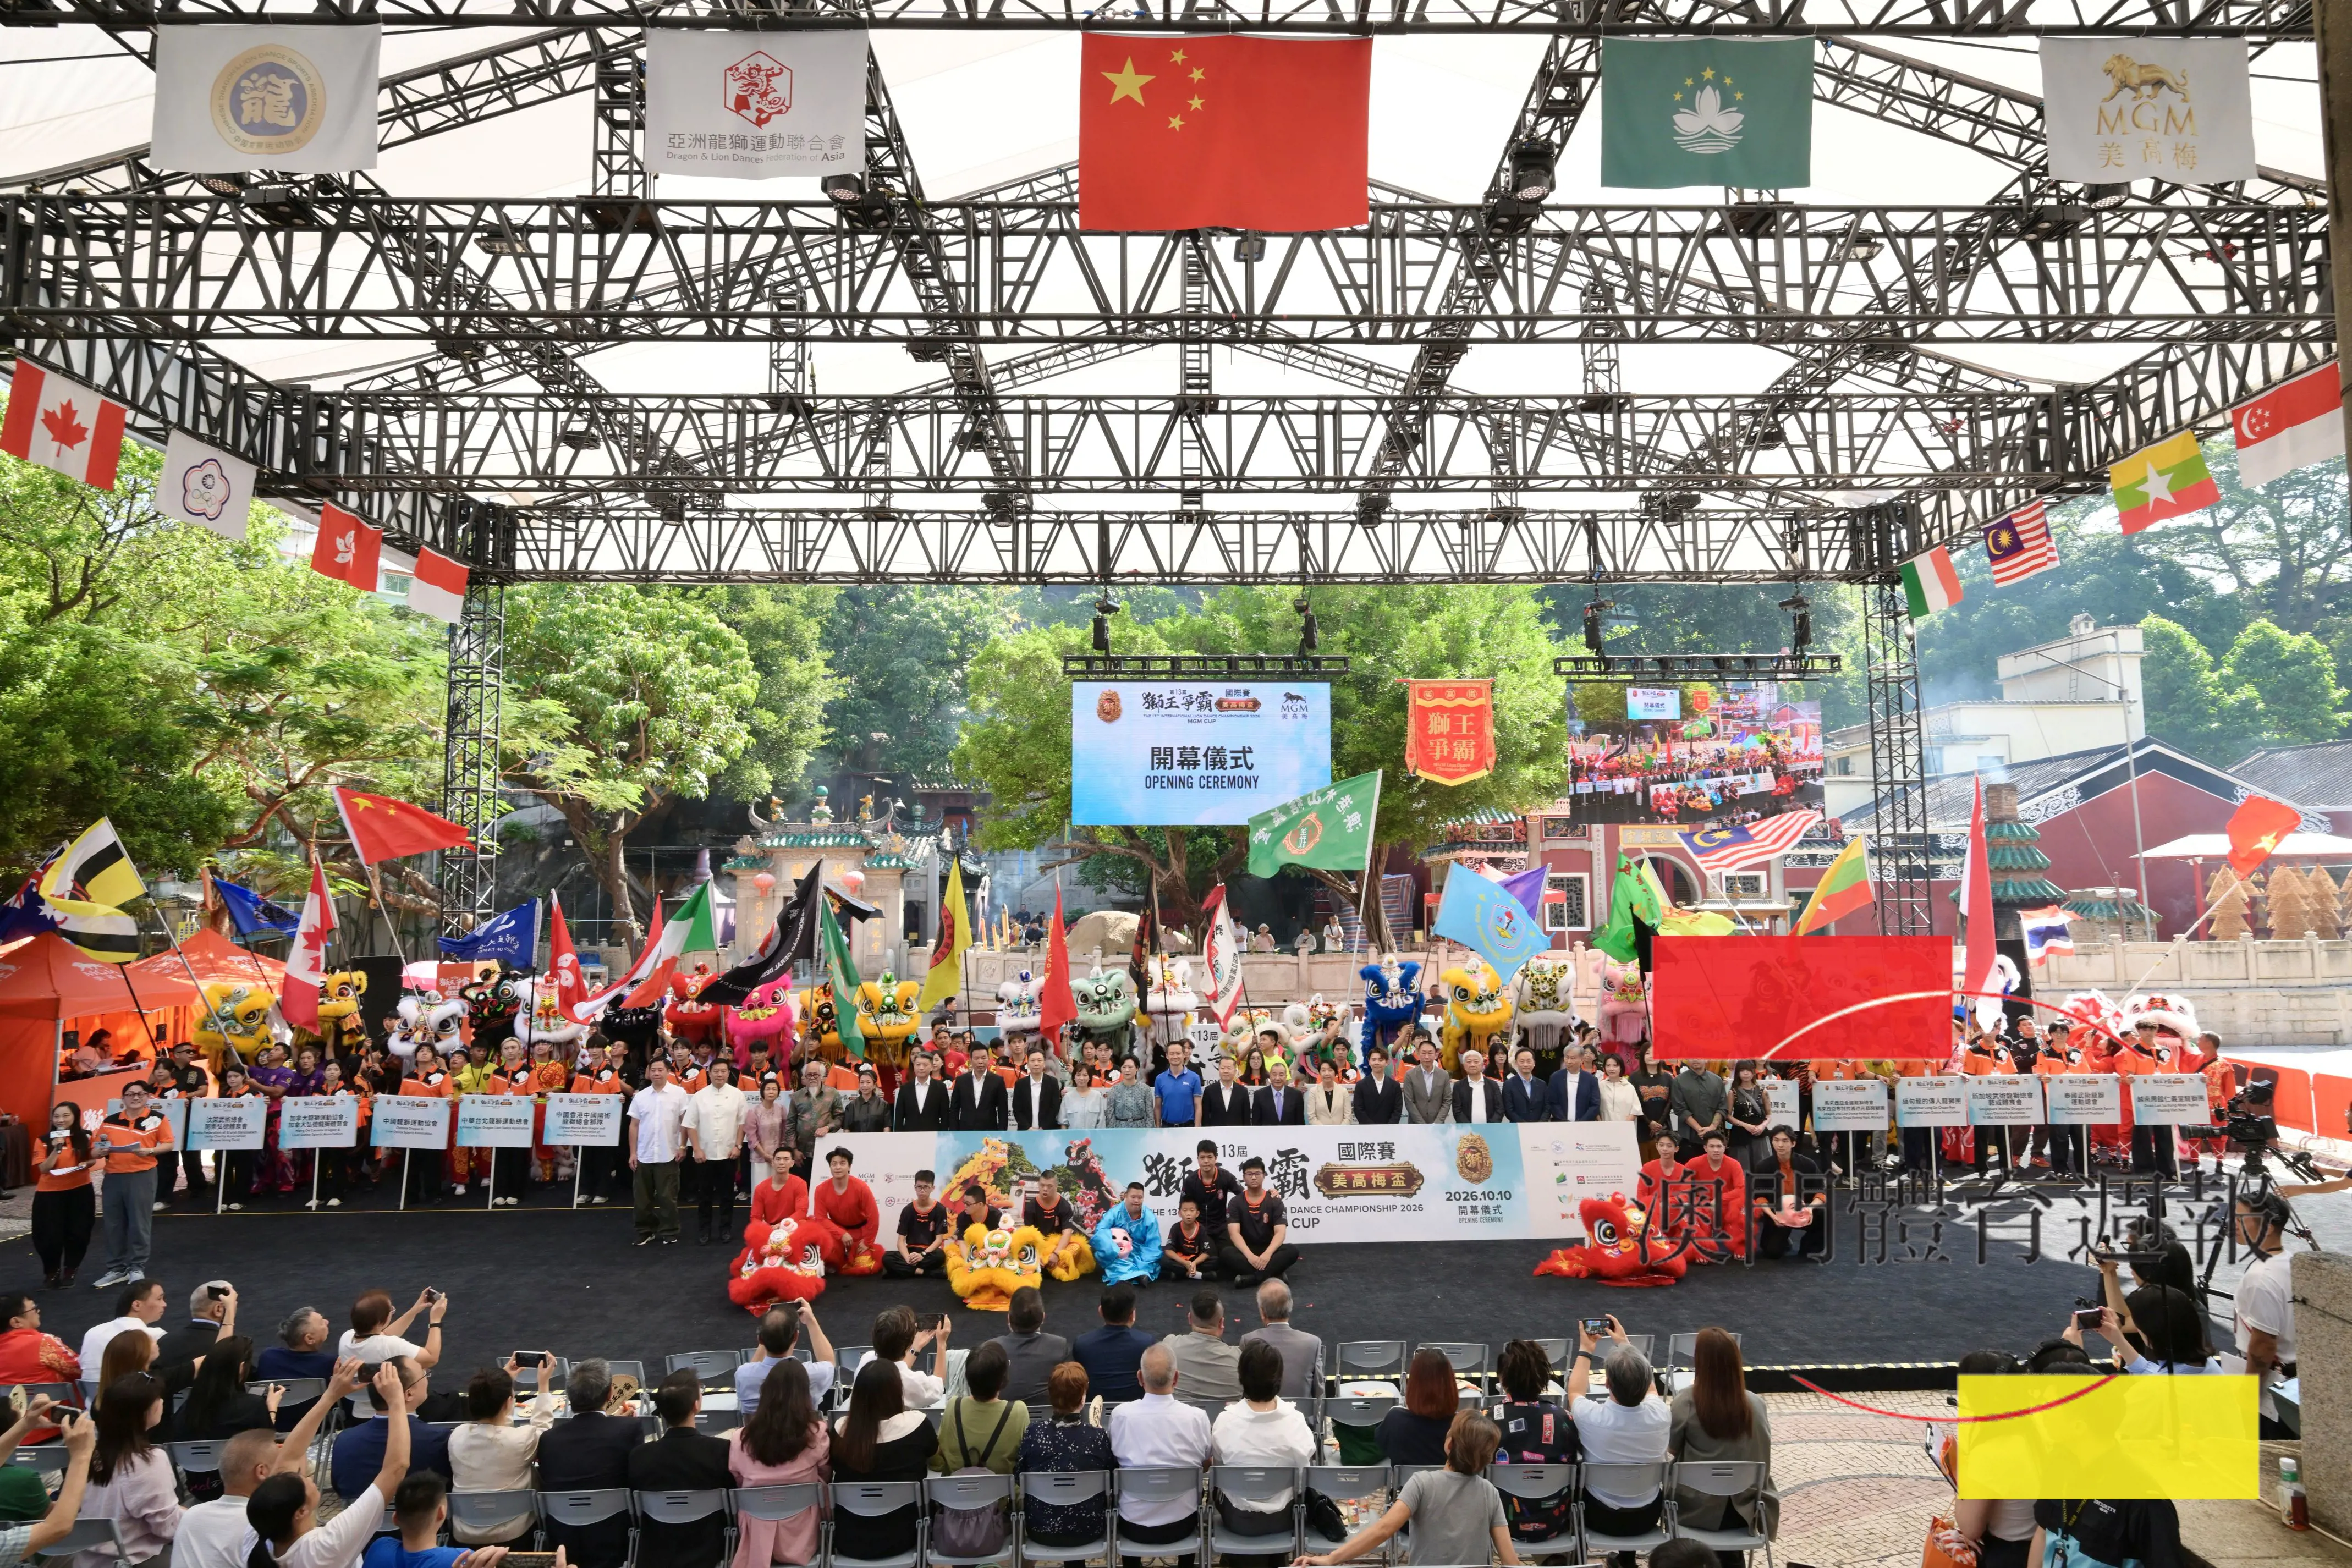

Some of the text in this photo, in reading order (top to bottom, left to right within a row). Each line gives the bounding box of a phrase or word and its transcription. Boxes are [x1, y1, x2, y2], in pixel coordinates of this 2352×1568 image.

[259, 51, 287, 60] DANCE
[287, 57, 311, 82] SPORTS
[302, 83, 318, 134] ASSOCIATION
[2093, 101, 2199, 137] MGM
[667, 133, 845, 152] 亞洲龍獅運動聯合會
[667, 151, 698, 162] Dragon
[711, 153, 729, 161] Lion
[733, 153, 763, 163] Dances
[766, 153, 807, 162] Federation
[821, 151, 845, 162] Asia
[2098, 137, 2199, 170] 美高梅
[1226, 689, 1250, 697] 國際賽
[1142, 691, 1213, 713] 獅王爭霸
[1281, 704, 1308, 712] MGM
[1427, 712, 1476, 735] 獅王
[1427, 738, 1476, 761] 爭霸
[1150, 746, 1254, 771] 開幕儀式
[1145, 775, 1259, 789] OPENING CEREMONY
[383, 1118, 438, 1127] 中國龍獅運動協會
[461, 1117, 529, 1125] 中華台北龍獅運動總會
[556, 1111, 611, 1119] 中國香港中國國術
[1338, 1141, 1395, 1161] 國際賽
[1142, 1148, 1310, 1201] 獅霸
[1332, 1172, 1406, 1188] 美高梅盃
[1445, 1190, 1512, 1202] 2026.10.10
[1325, 1204, 1397, 1213] CHAMPIONSHIP
[1458, 1204, 1503, 1217] 開幕儀式
[1292, 1218, 1320, 1229] CUP
